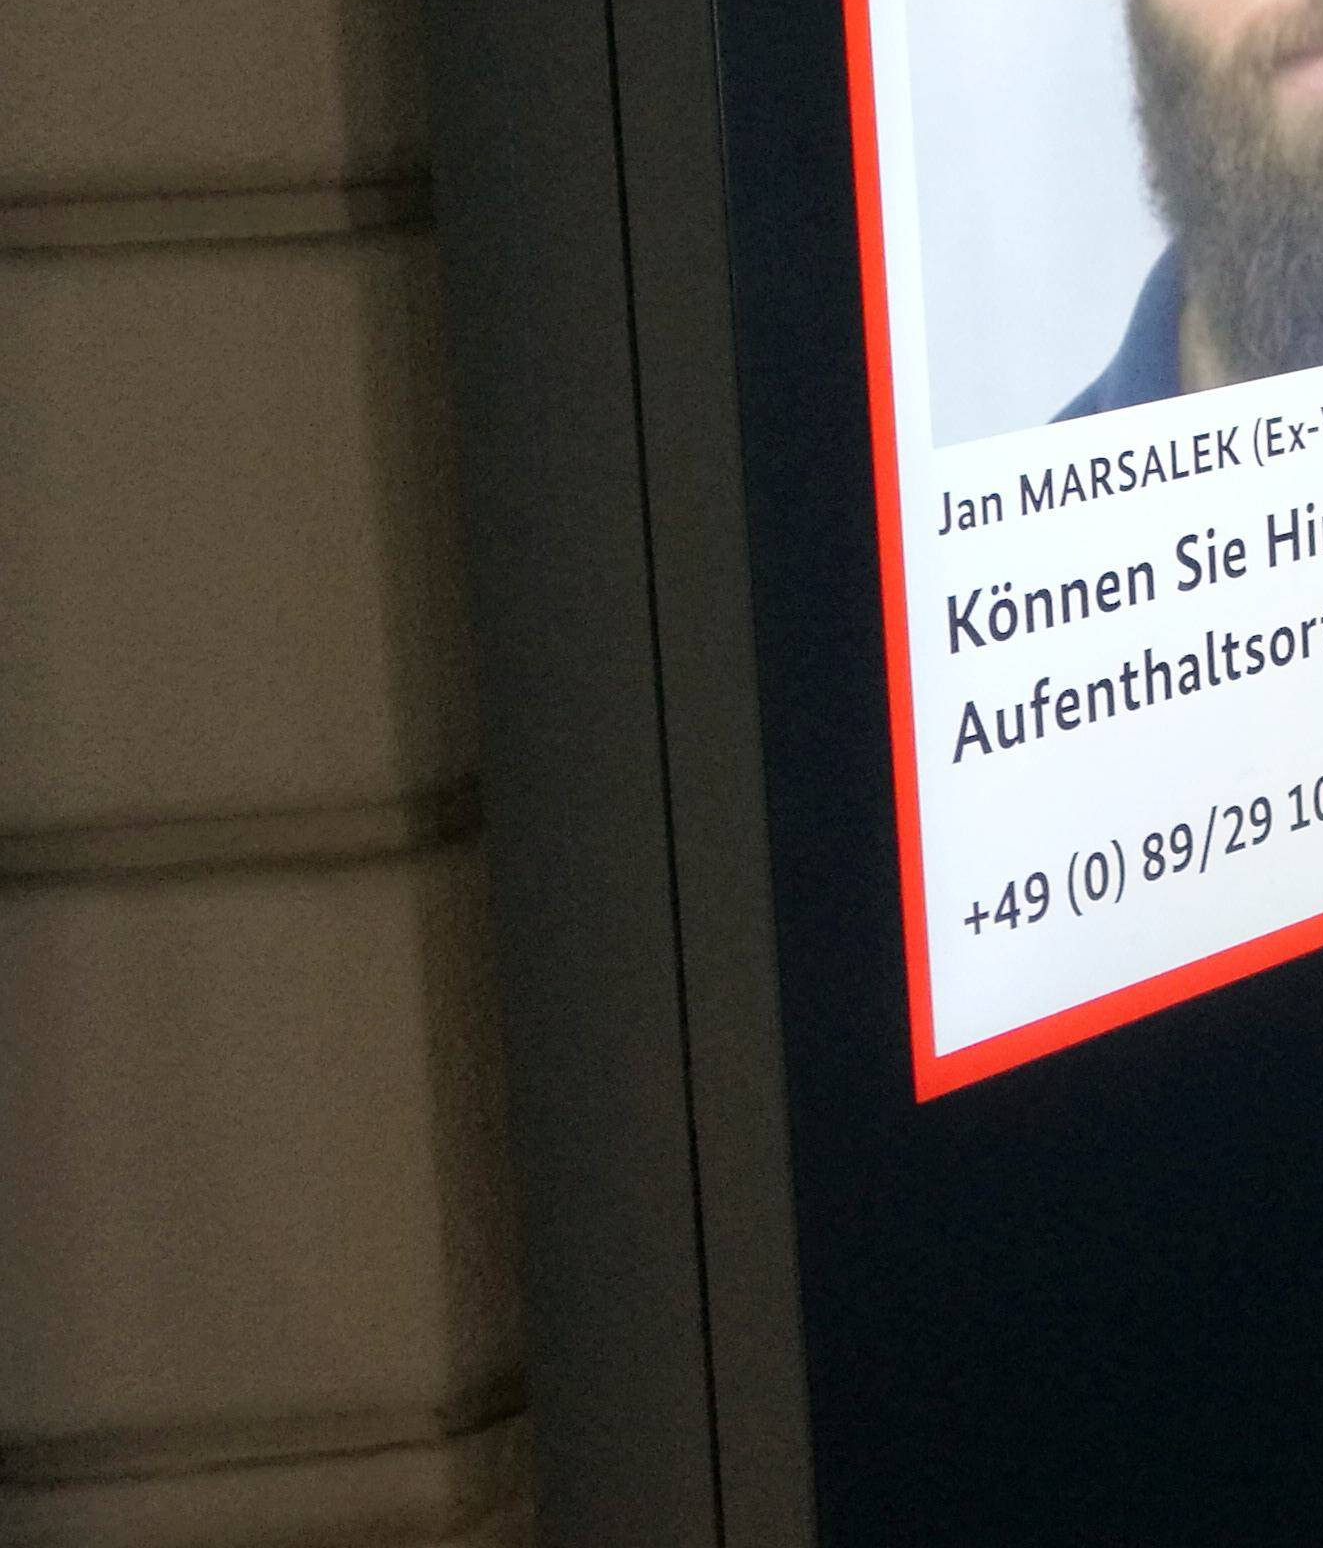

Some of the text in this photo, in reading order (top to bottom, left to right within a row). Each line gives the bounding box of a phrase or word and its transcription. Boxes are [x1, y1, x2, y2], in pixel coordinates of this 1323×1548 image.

[938, 489, 1001, 536] Jan
[1019, 426, 1241, 517] MARSALEK
[946, 561, 1157, 655] Können
[1176, 528, 1249, 593] Sie
[963, 868, 1051, 938] +49
[1066, 838, 1128, 918] (0)
[1140, 794, 1274, 884] 89/29
